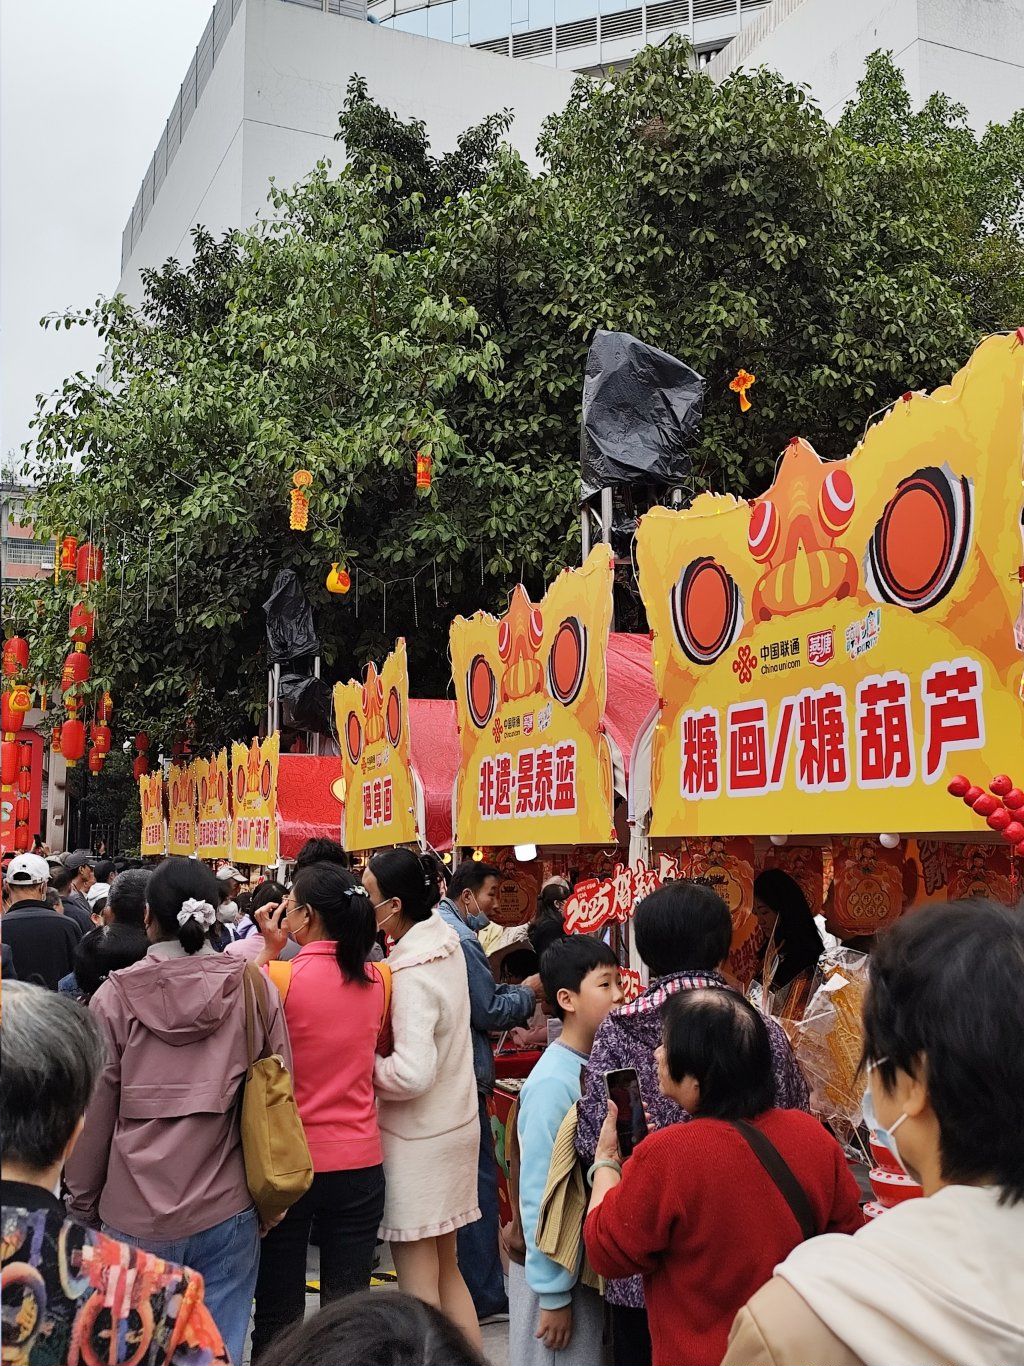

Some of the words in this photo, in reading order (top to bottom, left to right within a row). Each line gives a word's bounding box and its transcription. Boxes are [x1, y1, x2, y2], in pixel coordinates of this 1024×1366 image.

[760, 637, 800, 661] 中国联通
[683, 667, 979, 793] 糖画/糖葫芦
[364, 779, 392, 826] 通草画
[479, 745, 575, 815] 非遗·景泰蓝
